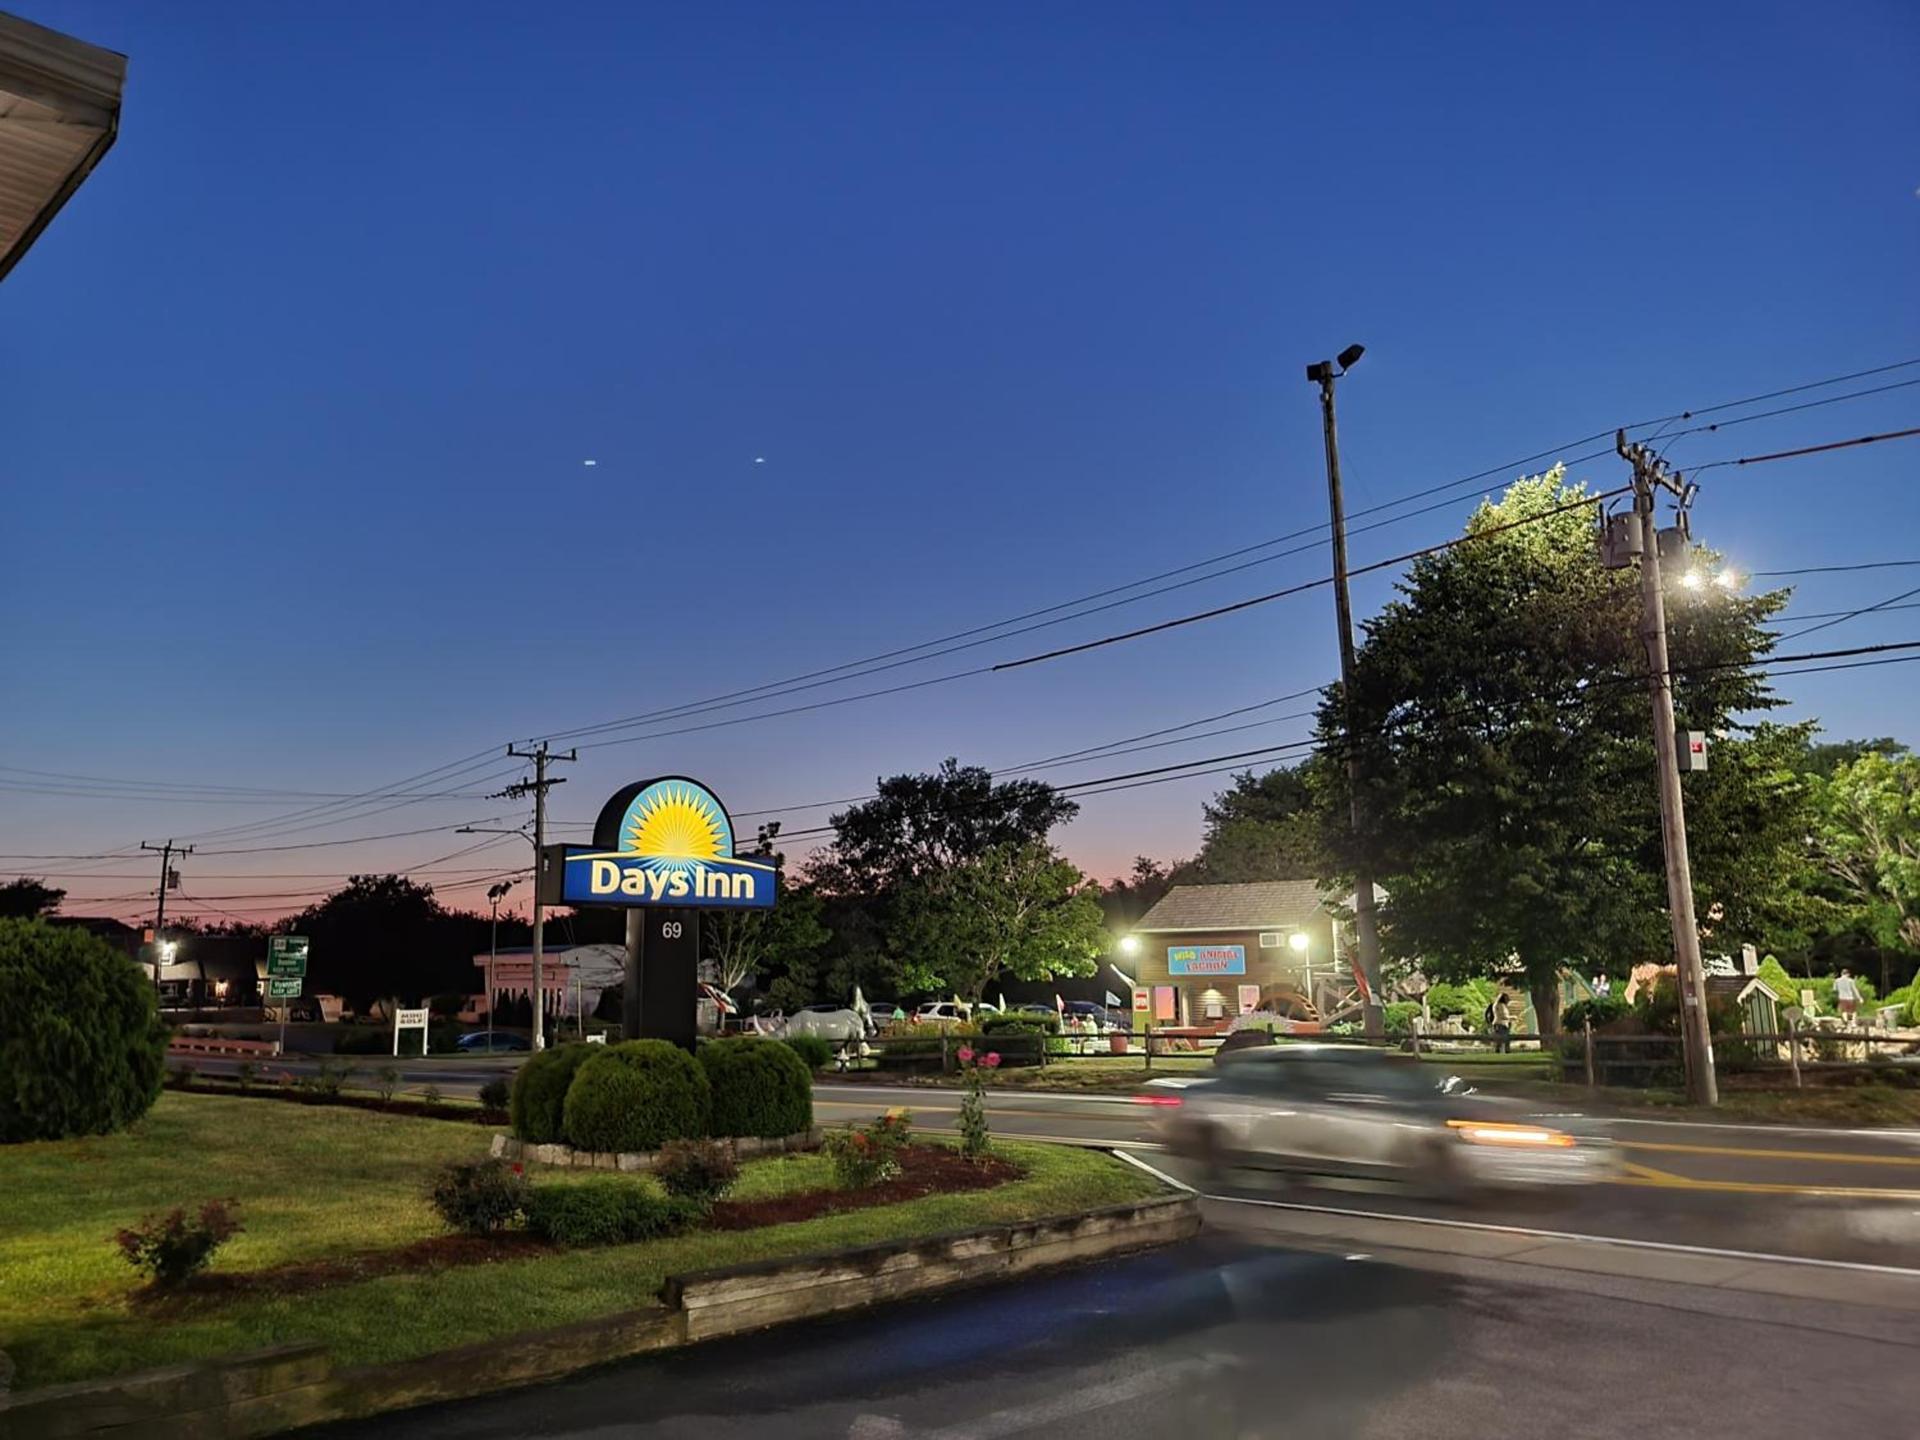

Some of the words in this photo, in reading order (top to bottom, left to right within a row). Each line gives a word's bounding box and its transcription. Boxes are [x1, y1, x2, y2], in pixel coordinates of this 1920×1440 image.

[591, 860, 689, 901] Days
[695, 863, 755, 899] Inn
[662, 921, 682, 939] 69
